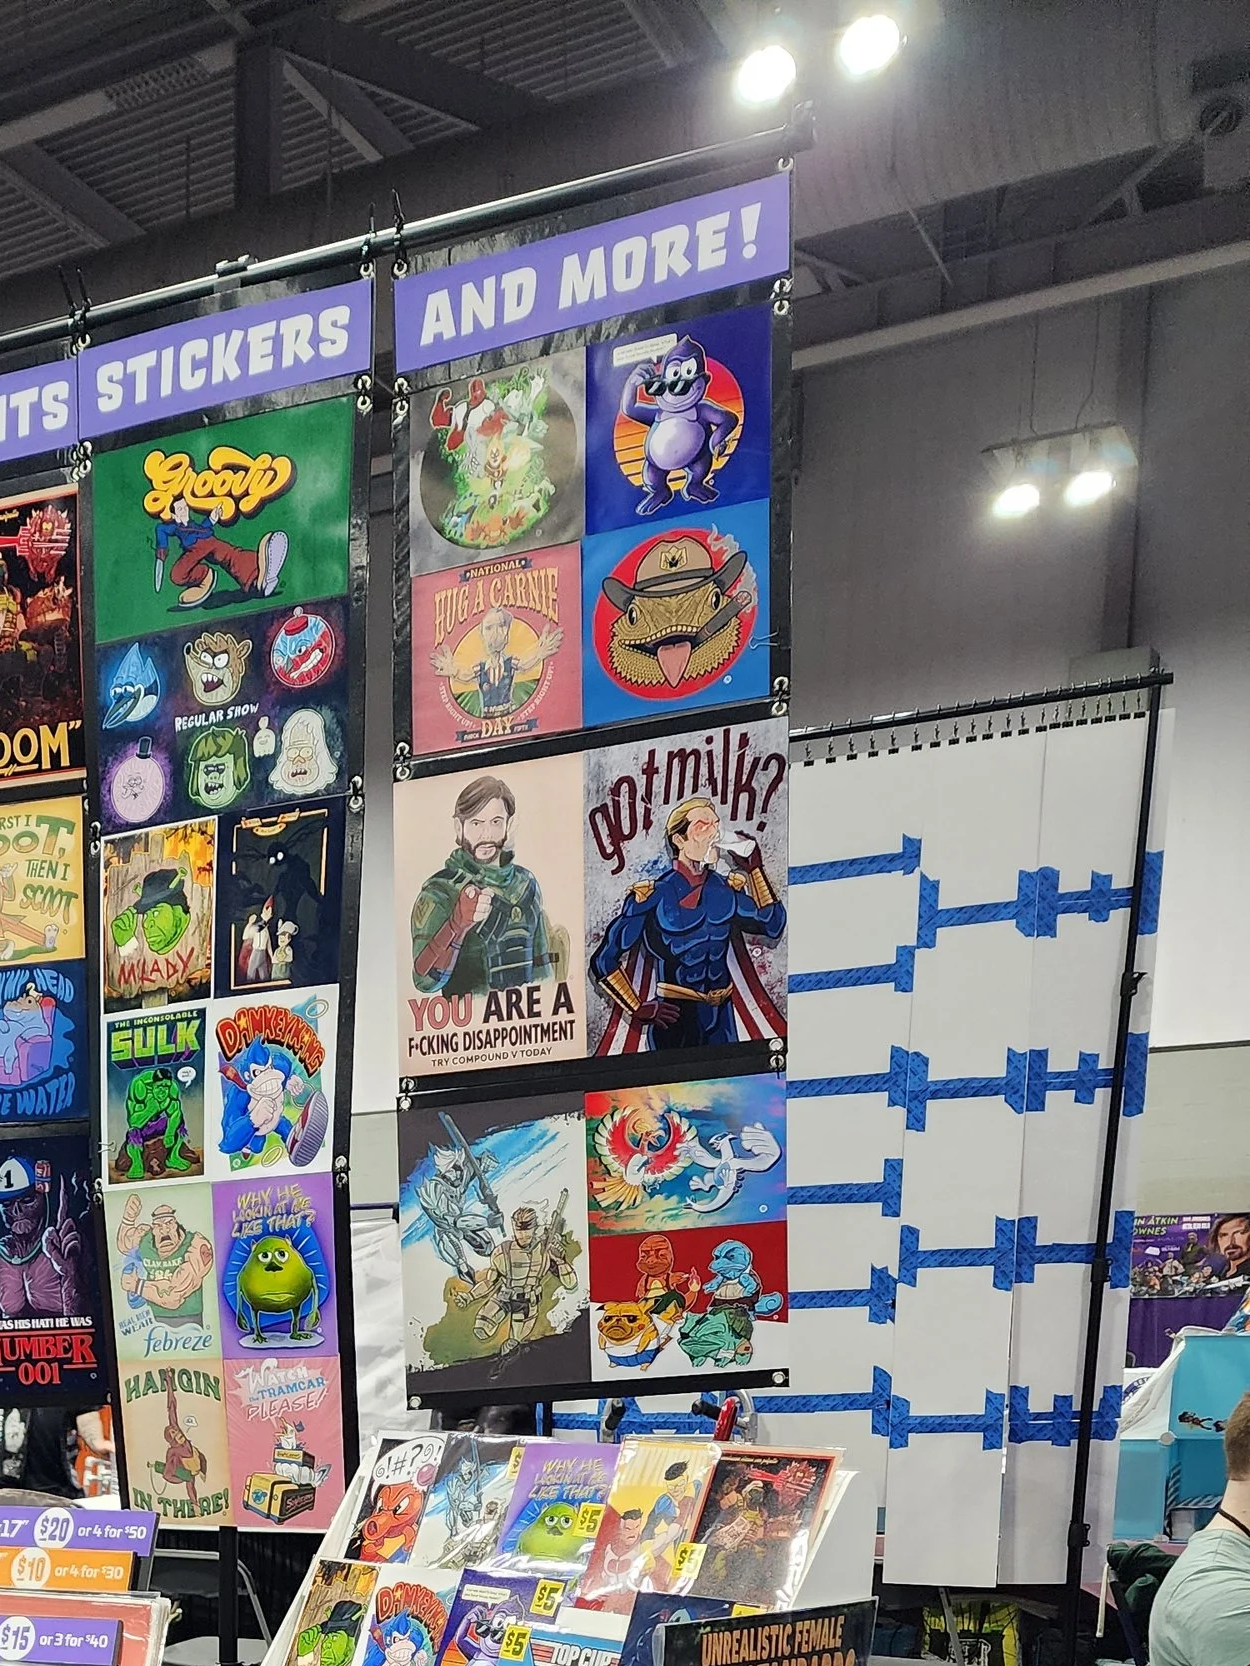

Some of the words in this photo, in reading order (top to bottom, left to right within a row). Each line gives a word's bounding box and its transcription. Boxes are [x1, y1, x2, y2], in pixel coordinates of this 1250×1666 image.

[419, 264, 538, 348] AND
[556, 202, 762, 298] MORE!
[96, 304, 352, 415] STICKERS
[144, 446, 298, 523] Groovy
[470, 560, 522, 578] NATIONAL
[434, 584, 469, 649] HUG
[472, 580, 485, 616] A
[489, 567, 559, 625] CARNIE
[174, 709, 224, 732] REGULAR
[226, 702, 260, 720] SHOW
[480, 715, 515, 739] DAY
[588, 747, 660, 876] got
[662, 727, 787, 833] milk?
[24, 814, 32, 827] I
[25, 858, 60, 880] THEN
[60, 862, 71, 881] I
[19, 883, 79, 925] SCOOT
[33, 967, 75, 1003] HEAD
[114, 1020, 132, 1030] THE
[133, 1011, 198, 1027] INCONSOLABLE
[407, 992, 472, 1032] YOU
[482, 984, 542, 1024] ARE
[551, 981, 576, 1016] A
[110, 1018, 202, 1064] SULK
[461, 1019, 576, 1053] DISAPPOINTMENT
[431, 1057, 450, 1068] TRY
[451, 1051, 509, 1066] COMPOUND
[511, 1050, 520, 1060] V
[519, 1046, 553, 1059] TODAY
[16, 1071, 76, 1116] WATER
[237, 1186, 273, 1210] WHY
[277, 1183, 302, 1201] HE
[273, 1200, 289, 1215] AT
[231, 1219, 263, 1240] LIKE
[266, 1208, 317, 1233] THAT?
[14, 1318, 31, 1330] HIS
[68, 1316, 93, 1327] WAS
[143, 1325, 214, 1358] febreze
[18, 1361, 61, 1386] 001
[124, 1366, 222, 1403] HANGIN
[258, 1377, 326, 1400] TRAMCAR
[246, 1387, 329, 1422] PLEASE!
[542, 1458, 576, 1472] WHY
[579, 1457, 603, 1472] HE
[132, 1487, 153, 1510] IN
[528, 1485, 560, 1499] LIKE
[39, 1515, 70, 1543] $20
[77, 1527, 92, 1538] or
[92, 1525, 101, 1537] 4
[103, 1524, 123, 1539] for
[124, 1526, 147, 1540] $50
[579, 1506, 603, 1533] $5
[16, 1554, 47, 1583] $10
[55, 1567, 68, 1577] or
[69, 1565, 79, 1577] 4
[80, 1564, 99, 1578] for
[101, 1565, 125, 1580] $30
[536, 1583, 560, 1612] $5
[0, 1623, 32, 1651] $15
[39, 1636, 54, 1647] or
[54, 1633, 63, 1647] 3
[65, 1633, 85, 1648] for
[85, 1634, 109, 1649] $40
[503, 1628, 528, 1656] $5
[794, 1615, 846, 1655] FEMALE
[551, 1645, 578, 1666] TOP
